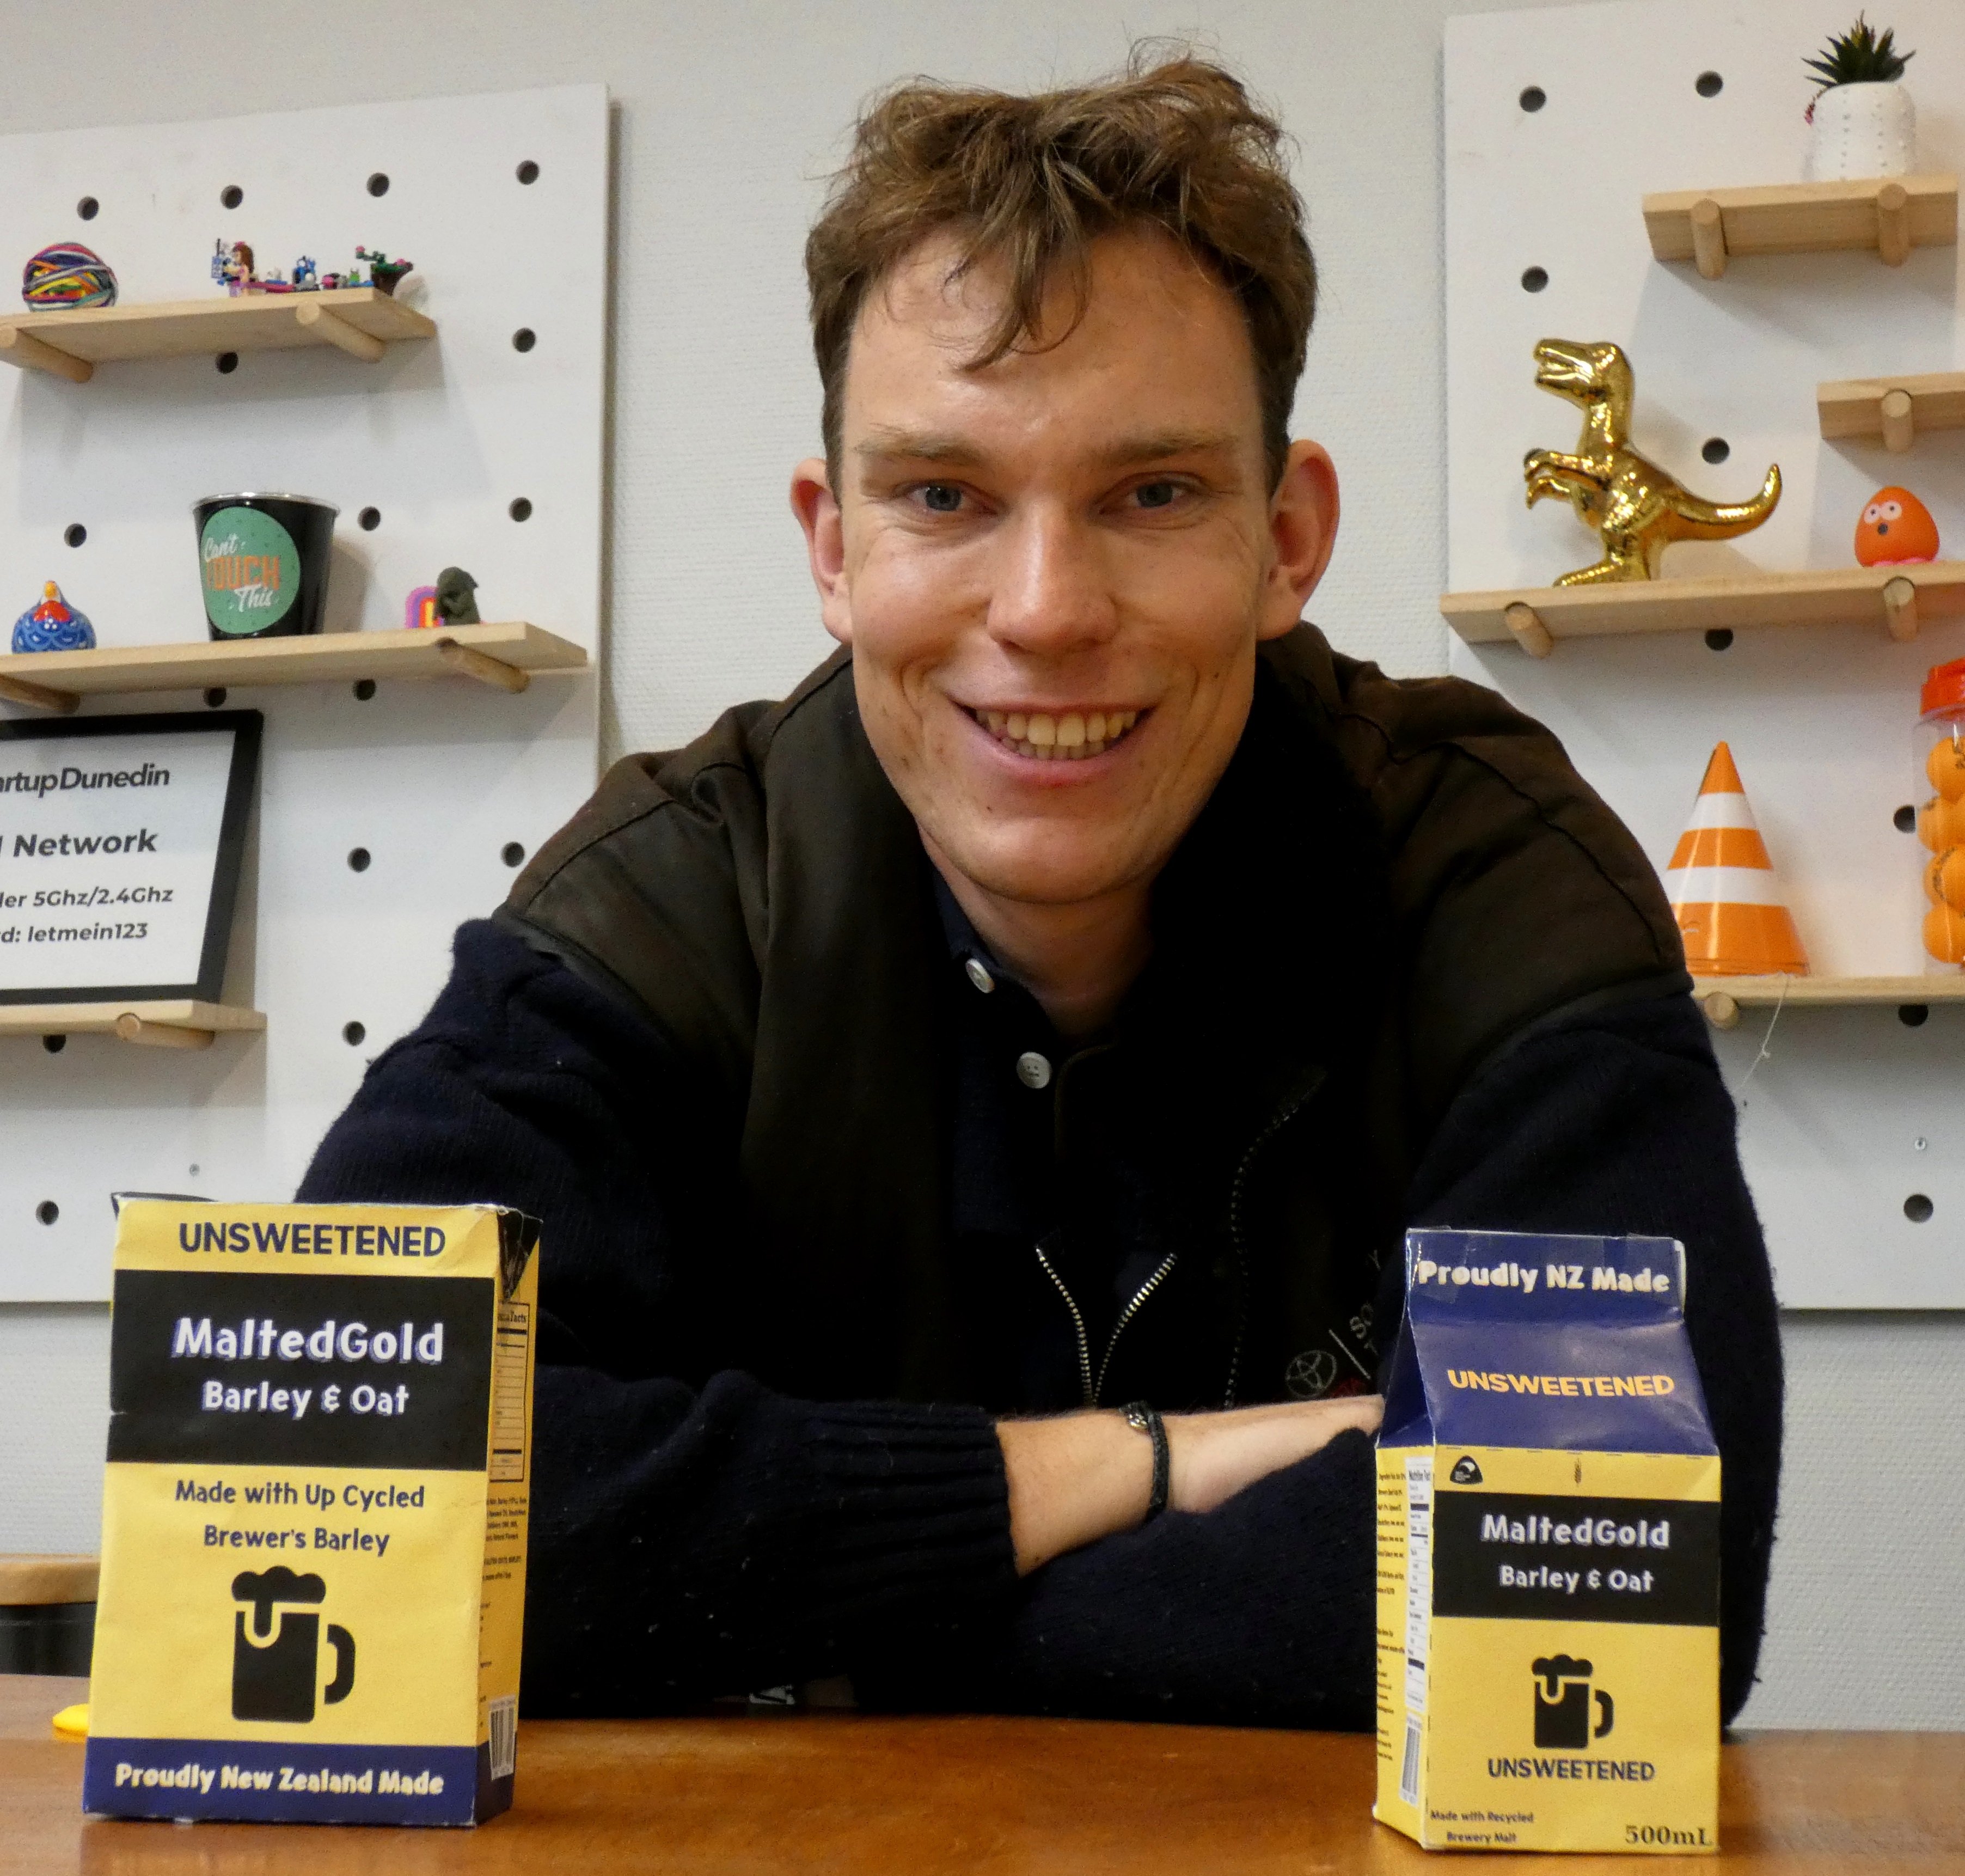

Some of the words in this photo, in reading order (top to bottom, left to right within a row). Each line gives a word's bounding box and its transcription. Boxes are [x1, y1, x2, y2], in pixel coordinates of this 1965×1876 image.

[234, 583, 274, 612] This
[13, 828, 157, 857] Network
[33, 886, 173, 907] 5Ghz/2.4Ghz
[0, 926, 21, 943] d:
[28, 922, 148, 942] letmein123
[179, 1222, 445, 1257] UNSWEETENED
[1417, 1260, 1539, 1293] Proudly
[1546, 1264, 1584, 1289] NZ
[1591, 1267, 1670, 1292] Made
[174, 1317, 443, 1362] MaltedGold
[1447, 1370, 1675, 1397] UNSWEETENED
[203, 1380, 312, 1419] Barley
[322, 1384, 341, 1412] &
[351, 1385, 409, 1415] Oat
[176, 1480, 236, 1504] Made
[244, 1482, 298, 1504] with
[305, 1484, 335, 1511] Up
[342, 1484, 425, 1512] Cycled
[204, 1525, 307, 1549] Brewer's
[314, 1527, 390, 1557] Barley
[1483, 1514, 1669, 1548] MaltedGold
[1500, 1565, 1580, 1593] Barley
[1587, 1569, 1601, 1589] &
[1608, 1569, 1654, 1592] Oat
[115, 1763, 216, 1794] Proudly
[221, 1765, 273, 1789] New
[278, 1767, 373, 1793] Zealand
[378, 1770, 444, 1795] Made
[1488, 1758, 1655, 1781] UNSWEETENED
[1625, 1824, 1712, 1846] 500mL
